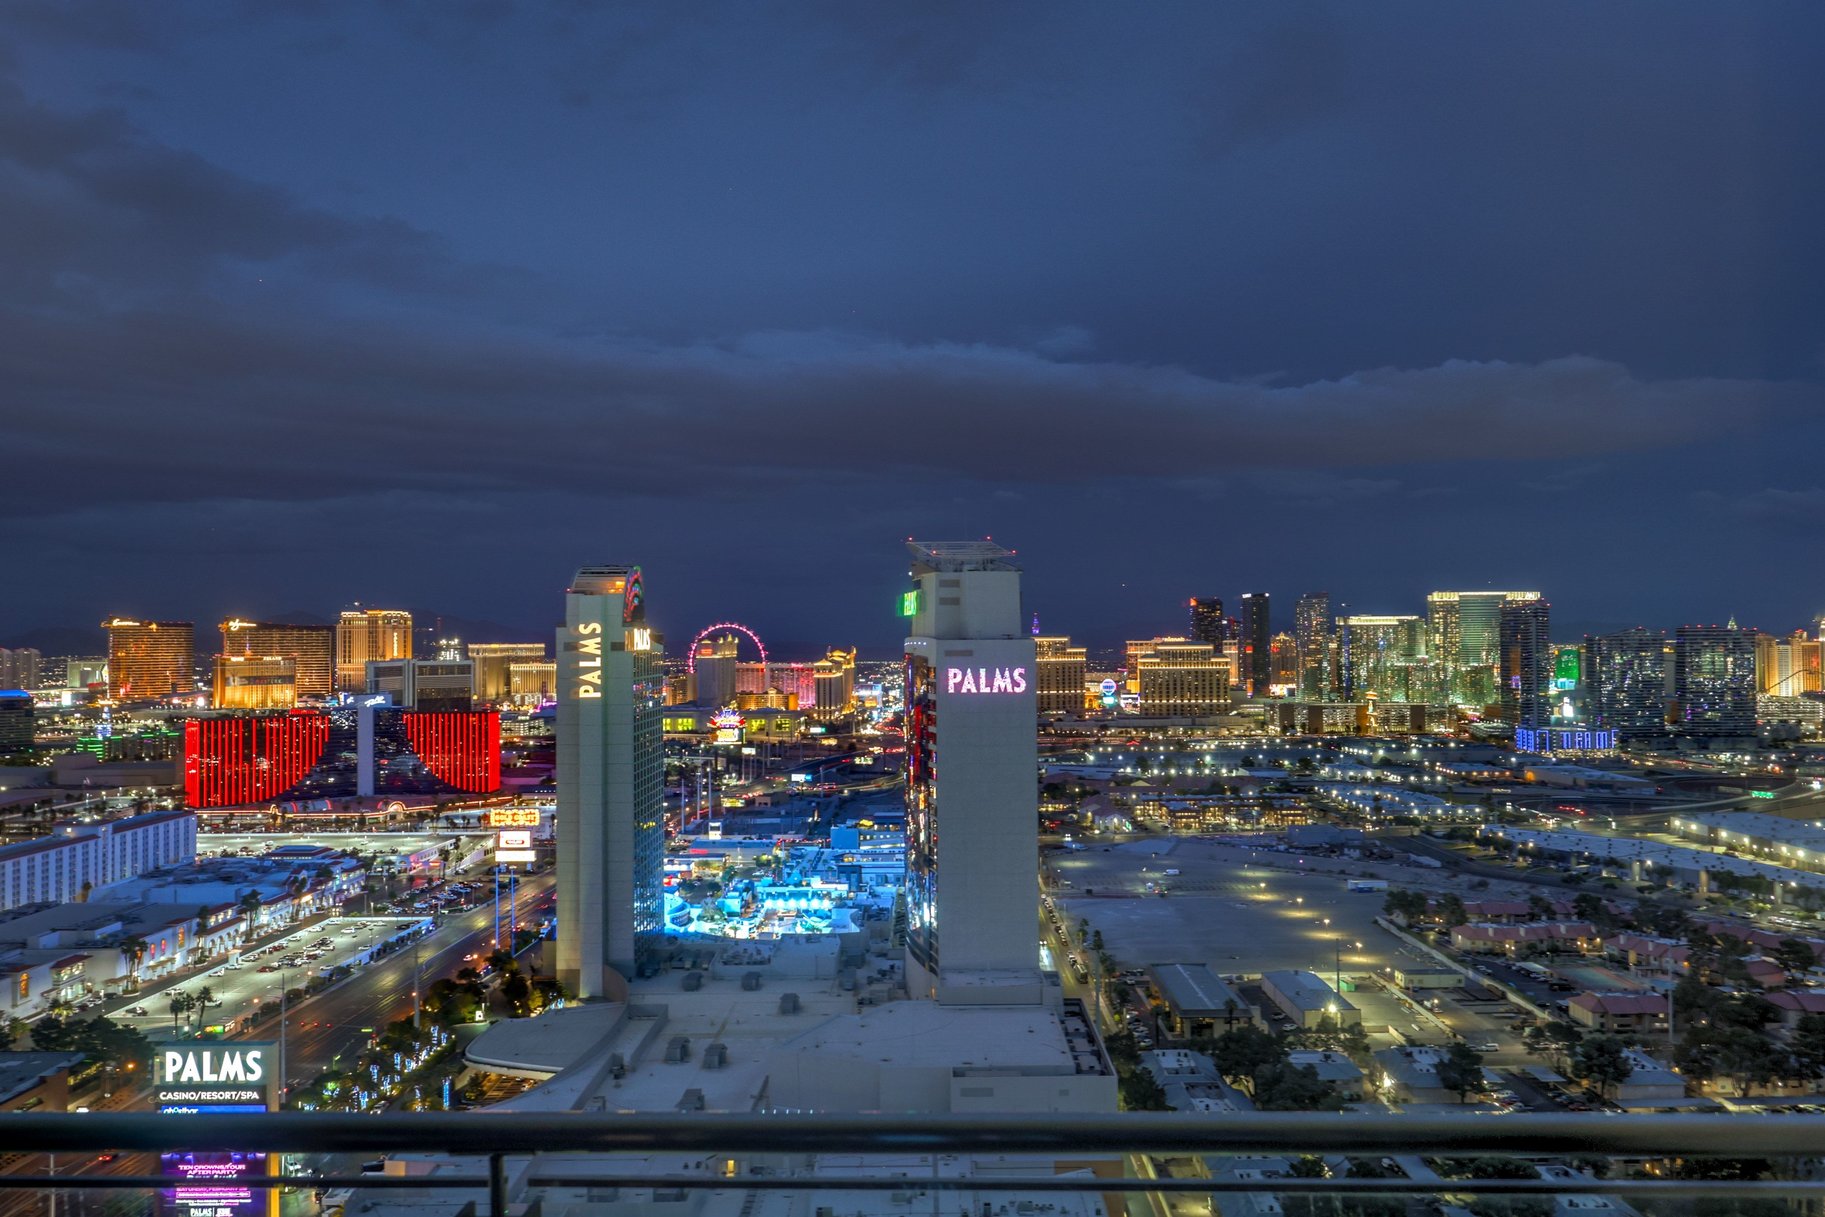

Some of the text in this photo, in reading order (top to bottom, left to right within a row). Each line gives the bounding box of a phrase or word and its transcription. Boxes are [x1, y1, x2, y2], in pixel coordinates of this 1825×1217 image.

[579, 622, 602, 698] PALMS
[947, 667, 1027, 693] PALMS
[165, 1051, 262, 1082] PALMS
[159, 1091, 259, 1101] CASINO/RESORT/SPA
